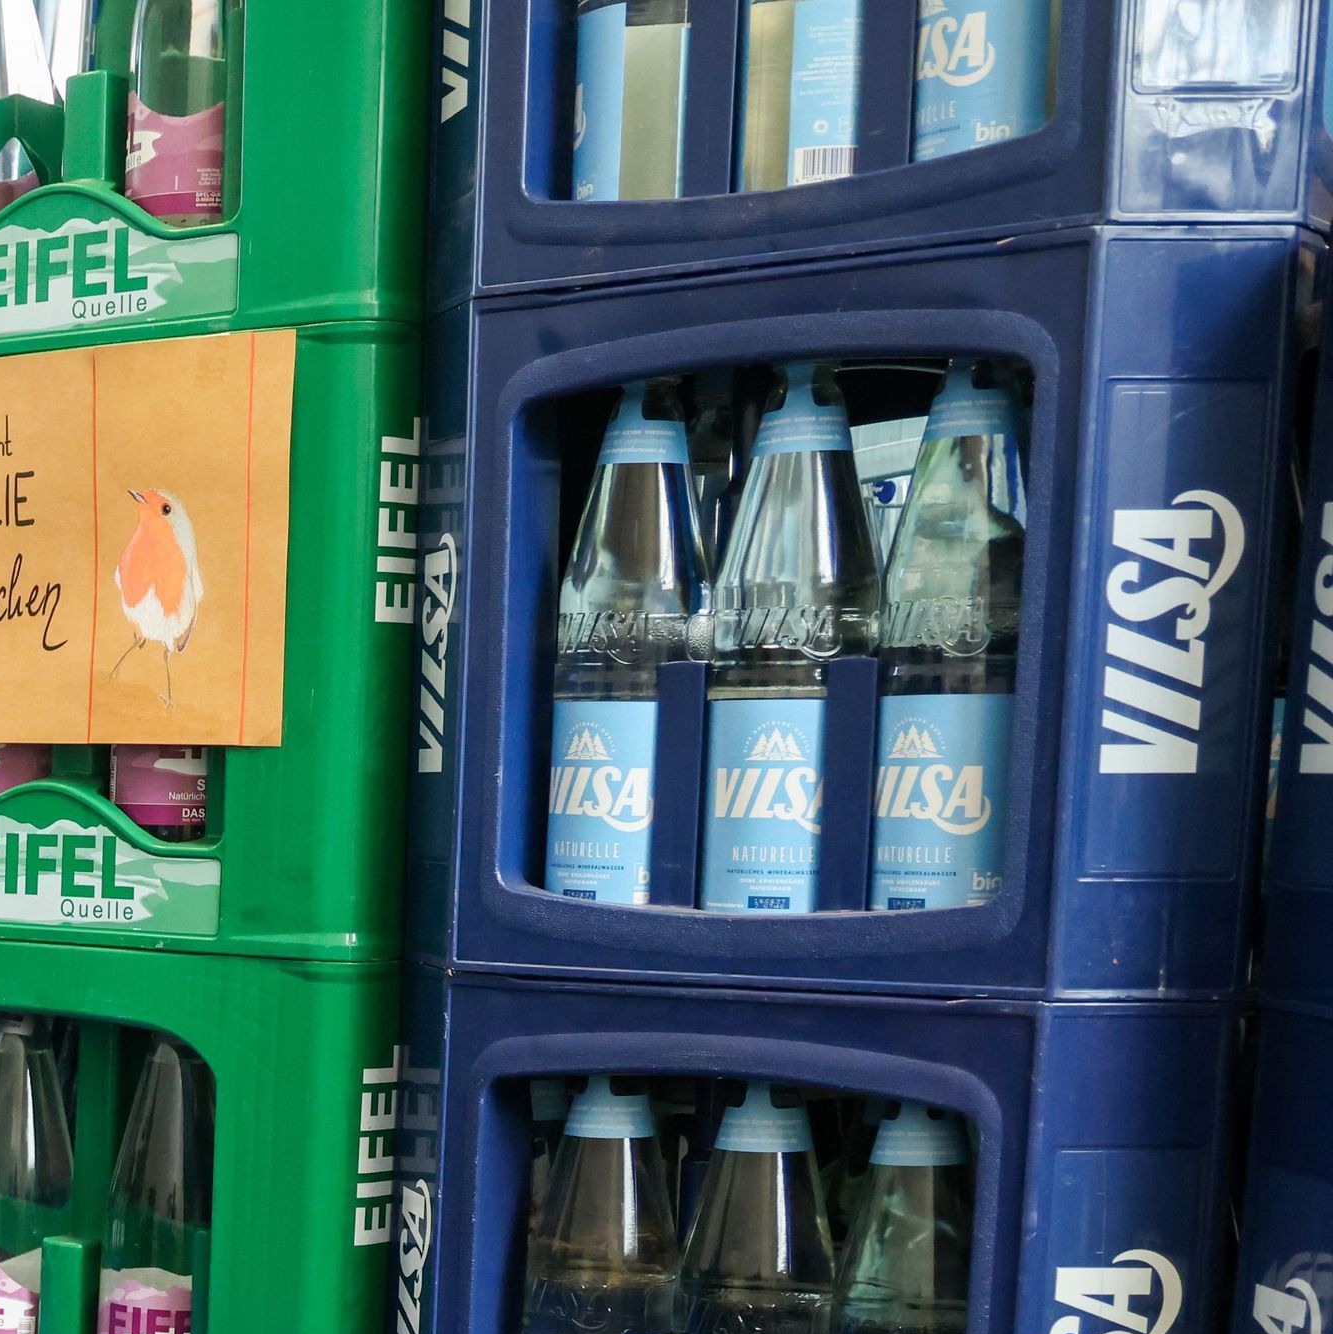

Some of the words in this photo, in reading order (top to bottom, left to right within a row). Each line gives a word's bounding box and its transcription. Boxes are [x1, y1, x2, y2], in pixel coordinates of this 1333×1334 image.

[976, 120, 1009, 142] bio
[71, 294, 148, 320] Quelle
[375, 417, 421, 624] EIFEL
[1100, 489, 1245, 774] VILSA
[418, 532, 457, 773] VILSA
[182, 807, 206, 818] DAS
[555, 840, 621, 859] NATURELLE
[733, 845, 815, 864] NATURELLE
[877, 846, 953, 865] NATURELLE
[60, 898, 134, 920] Quelle
[354, 1045, 400, 1246] EIFEL
